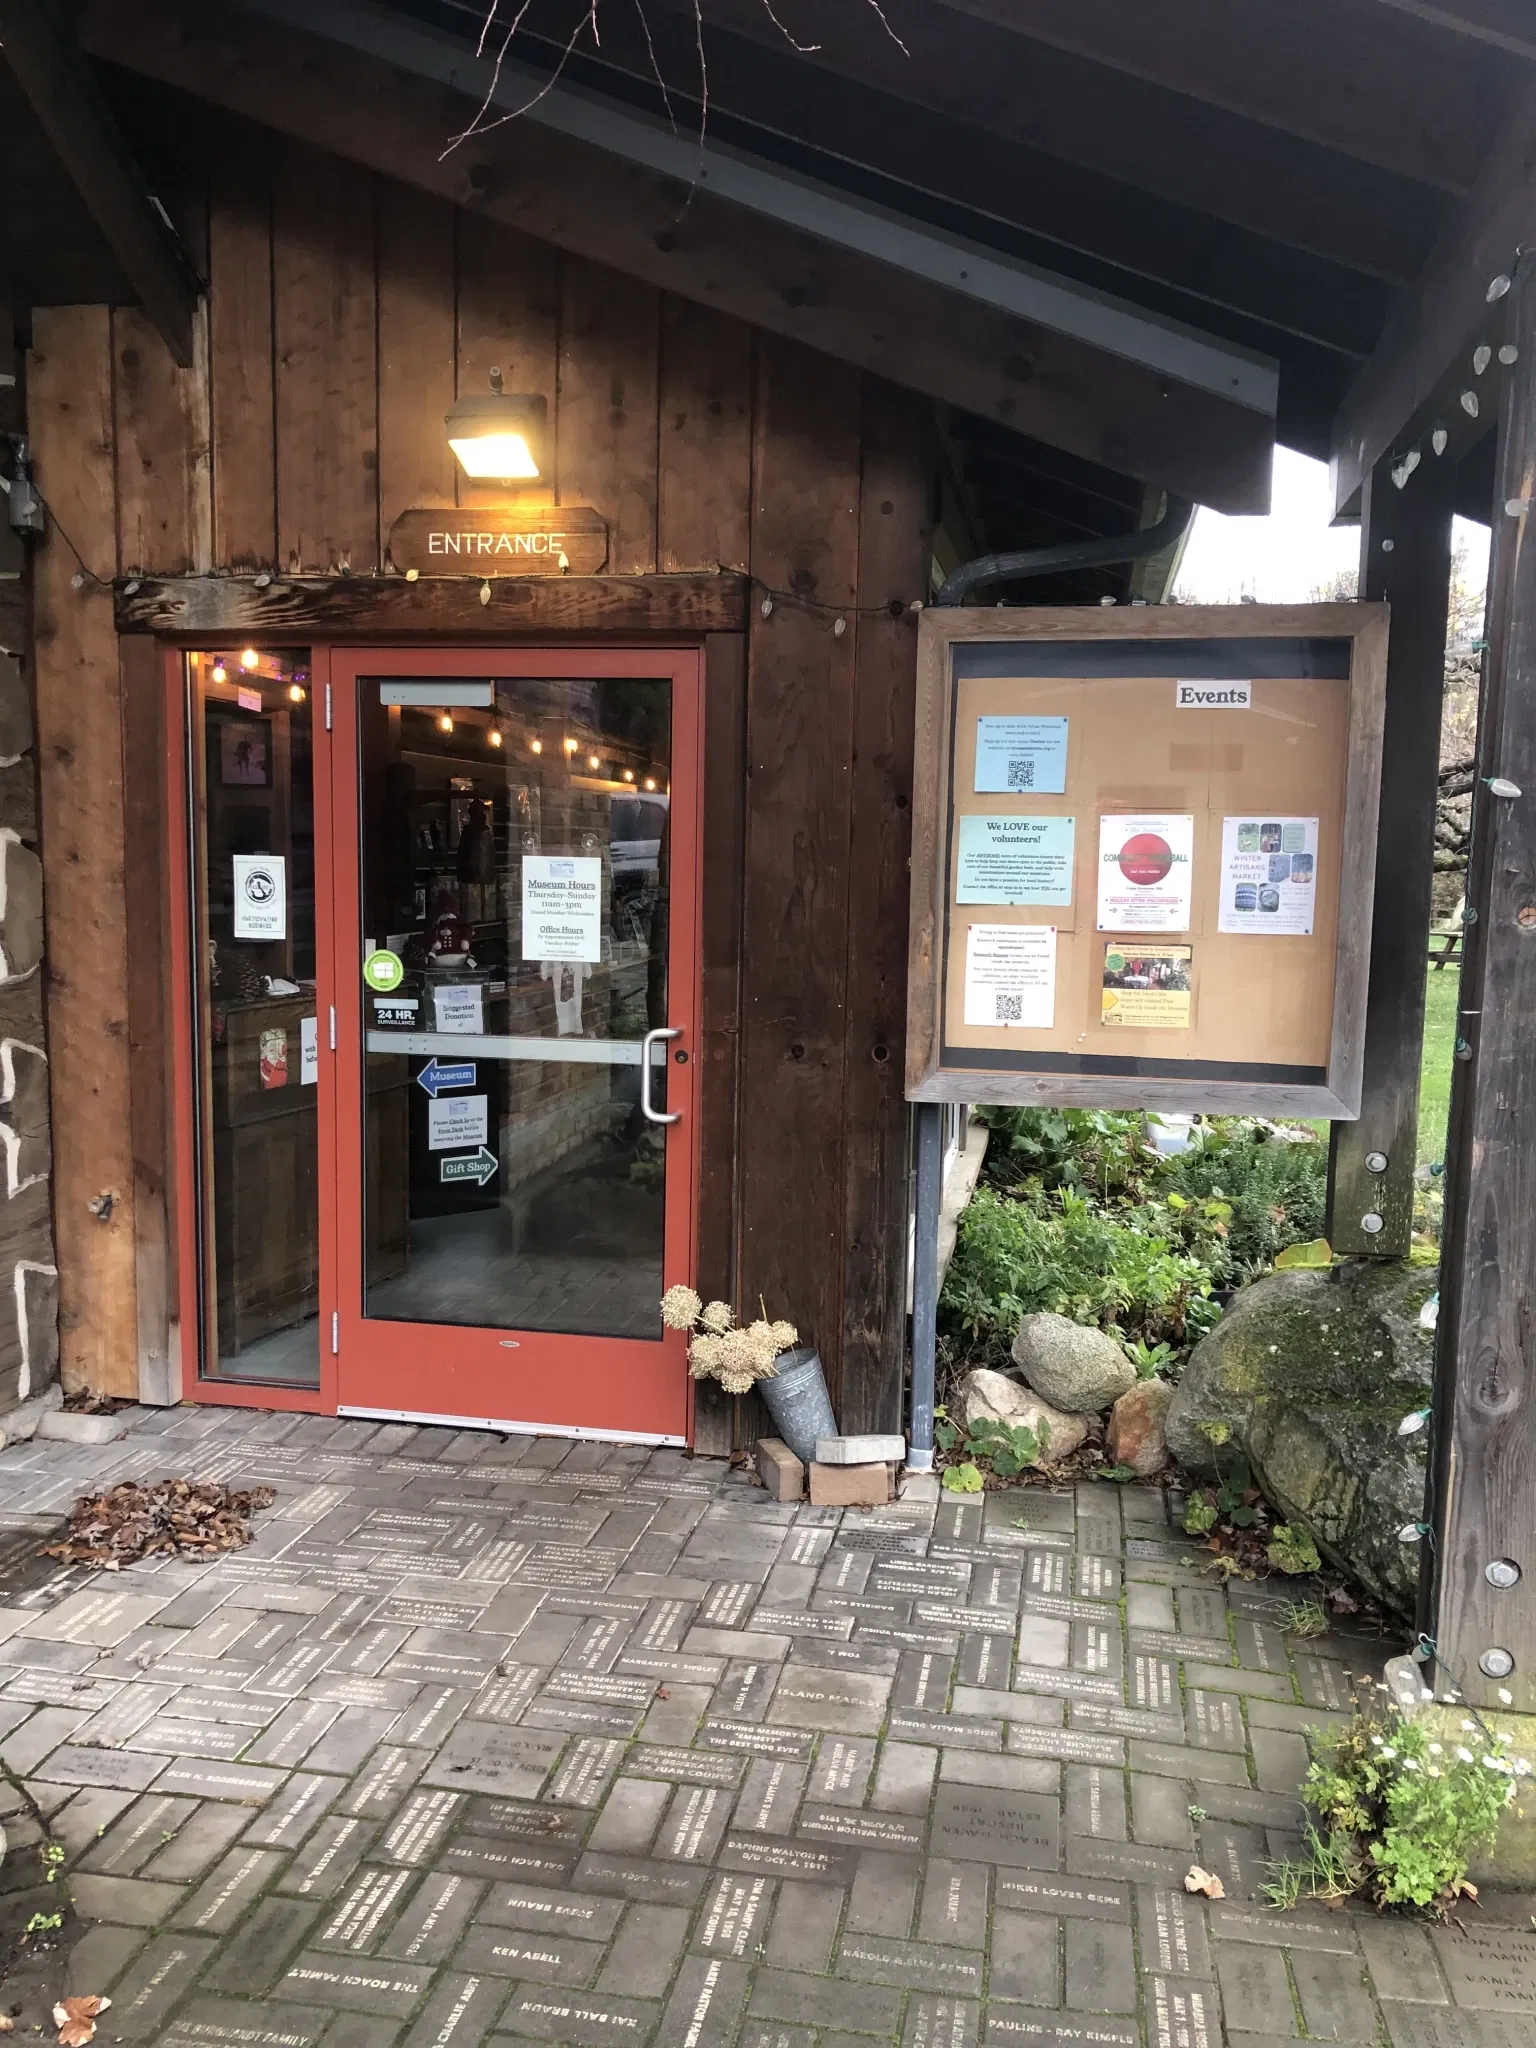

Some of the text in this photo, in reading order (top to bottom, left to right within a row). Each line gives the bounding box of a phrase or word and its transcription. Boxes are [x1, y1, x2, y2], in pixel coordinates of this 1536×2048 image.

[428, 532, 567, 554] ENTRANCE
[1180, 687, 1248, 704] Events
[986, 822, 1048, 832] We LOVE our
[991, 834, 1041, 844] volunteers!
[527, 879, 596, 891] Museum Hours
[528, 890, 596, 900] Thursday-Sunday
[541, 901, 582, 910] 11am-3pm
[539, 925, 584, 934] Office Hours
[442, 1004, 475, 1012] Suggested
[377, 1010, 416, 1020] 24 HR.
[429, 1070, 472, 1082] Museum
[438, 1127, 451, 1135] Front
[446, 1162, 491, 1174] Gift Shop
[878, 1564, 926, 1572] WINKELMAN
[593, 1601, 639, 1610] BUCHANAN
[850, 1602, 894, 1611] DANIELLE
[372, 1628, 388, 1644] SCOTT
[622, 1658, 668, 1667] MARGARET
[582, 1675, 614, 1683] ROGERS
[1084, 1680, 1115, 1689] ISLAND
[587, 1683, 632, 1692] DAUGHTER
[778, 1688, 824, 1699] ISLAND
[605, 1691, 645, 1700] SHERROD
[720, 1724, 754, 1732] LOVING
[757, 1728, 798, 1737] MEMORY
[930, 1724, 963, 1733] MALIA
[735, 1733, 780, 1743] "EMMETT"
[754, 1743, 773, 1751] DOG
[777, 1746, 799, 1754] EVER
[840, 1750, 856, 1787] HARRY AND
[679, 1815, 693, 1831] DALE
[308, 1819, 358, 1877] SYDNEY FOSTER,
[728, 1841, 815, 1859] DAPHNE WALTON
[732, 1888, 745, 1906] MAY
[1003, 1883, 1038, 1893] NIKKI
[1042, 1888, 1082, 1899] LOVES
[422, 1877, 460, 1930] GEORGIA AND
[508, 1899, 552, 1911] BRAUN
[323, 1927, 339, 1939] THE
[333, 1901, 357, 1925] BRAUNS
[350, 1889, 365, 1900] TED
[701, 1914, 720, 1946] COUNTY
[492, 1946, 519, 1957] KEN
[287, 1968, 418, 1993] THE ROACH FAMILY
[693, 1961, 721, 2021] HARRY PATTON
[521, 2002, 570, 2016] BRAUN
[575, 2010, 608, 2022] BALL
[437, 2003, 466, 2042] CHARLIE
[262, 2032, 309, 2046] FAMILY
